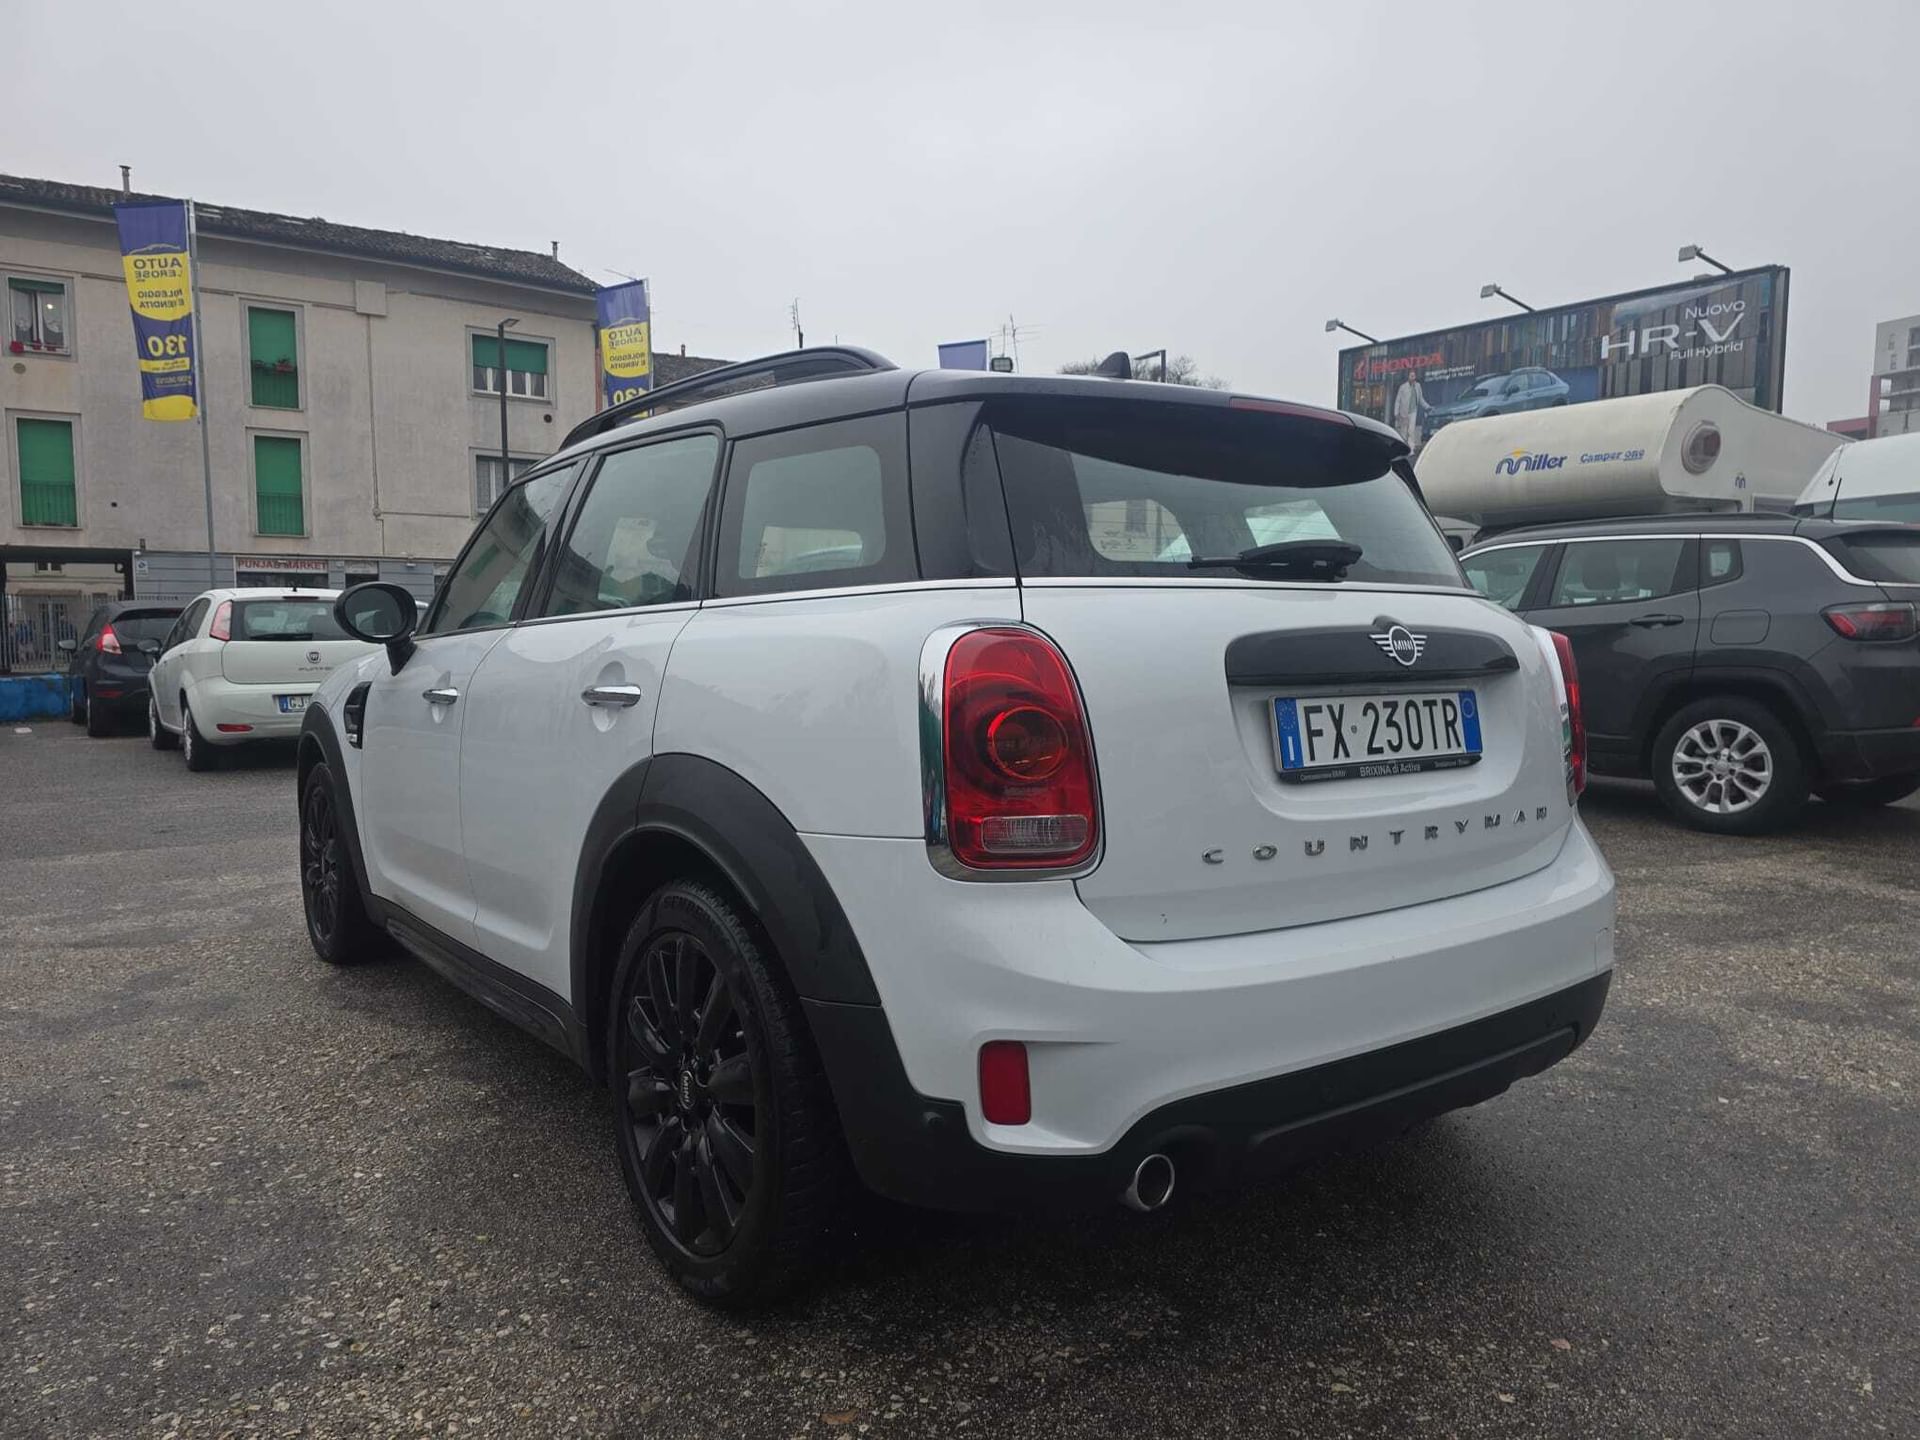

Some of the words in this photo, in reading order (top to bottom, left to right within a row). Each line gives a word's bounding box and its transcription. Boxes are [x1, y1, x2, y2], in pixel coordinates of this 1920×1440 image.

[1685, 300, 1746, 319] Nuovo
[1601, 312, 1745, 359] HR-V
[1670, 348, 1693, 360] Full
[1695, 341, 1744, 358] Hybrid
[1372, 352, 1444, 374] HONDA
[1580, 452, 1622, 464] Camper
[1624, 449, 1645, 461] one
[239, 560, 282, 569] PUNJAB
[285, 561, 327, 570] MARKET
[1393, 639, 1414, 651] MINI
[1303, 704, 1350, 761] FX
[1362, 698, 1462, 756] 230TR
[1360, 763, 1393, 777] BRIXINA
[1201, 806, 1547, 865] COUNTRYMAN
